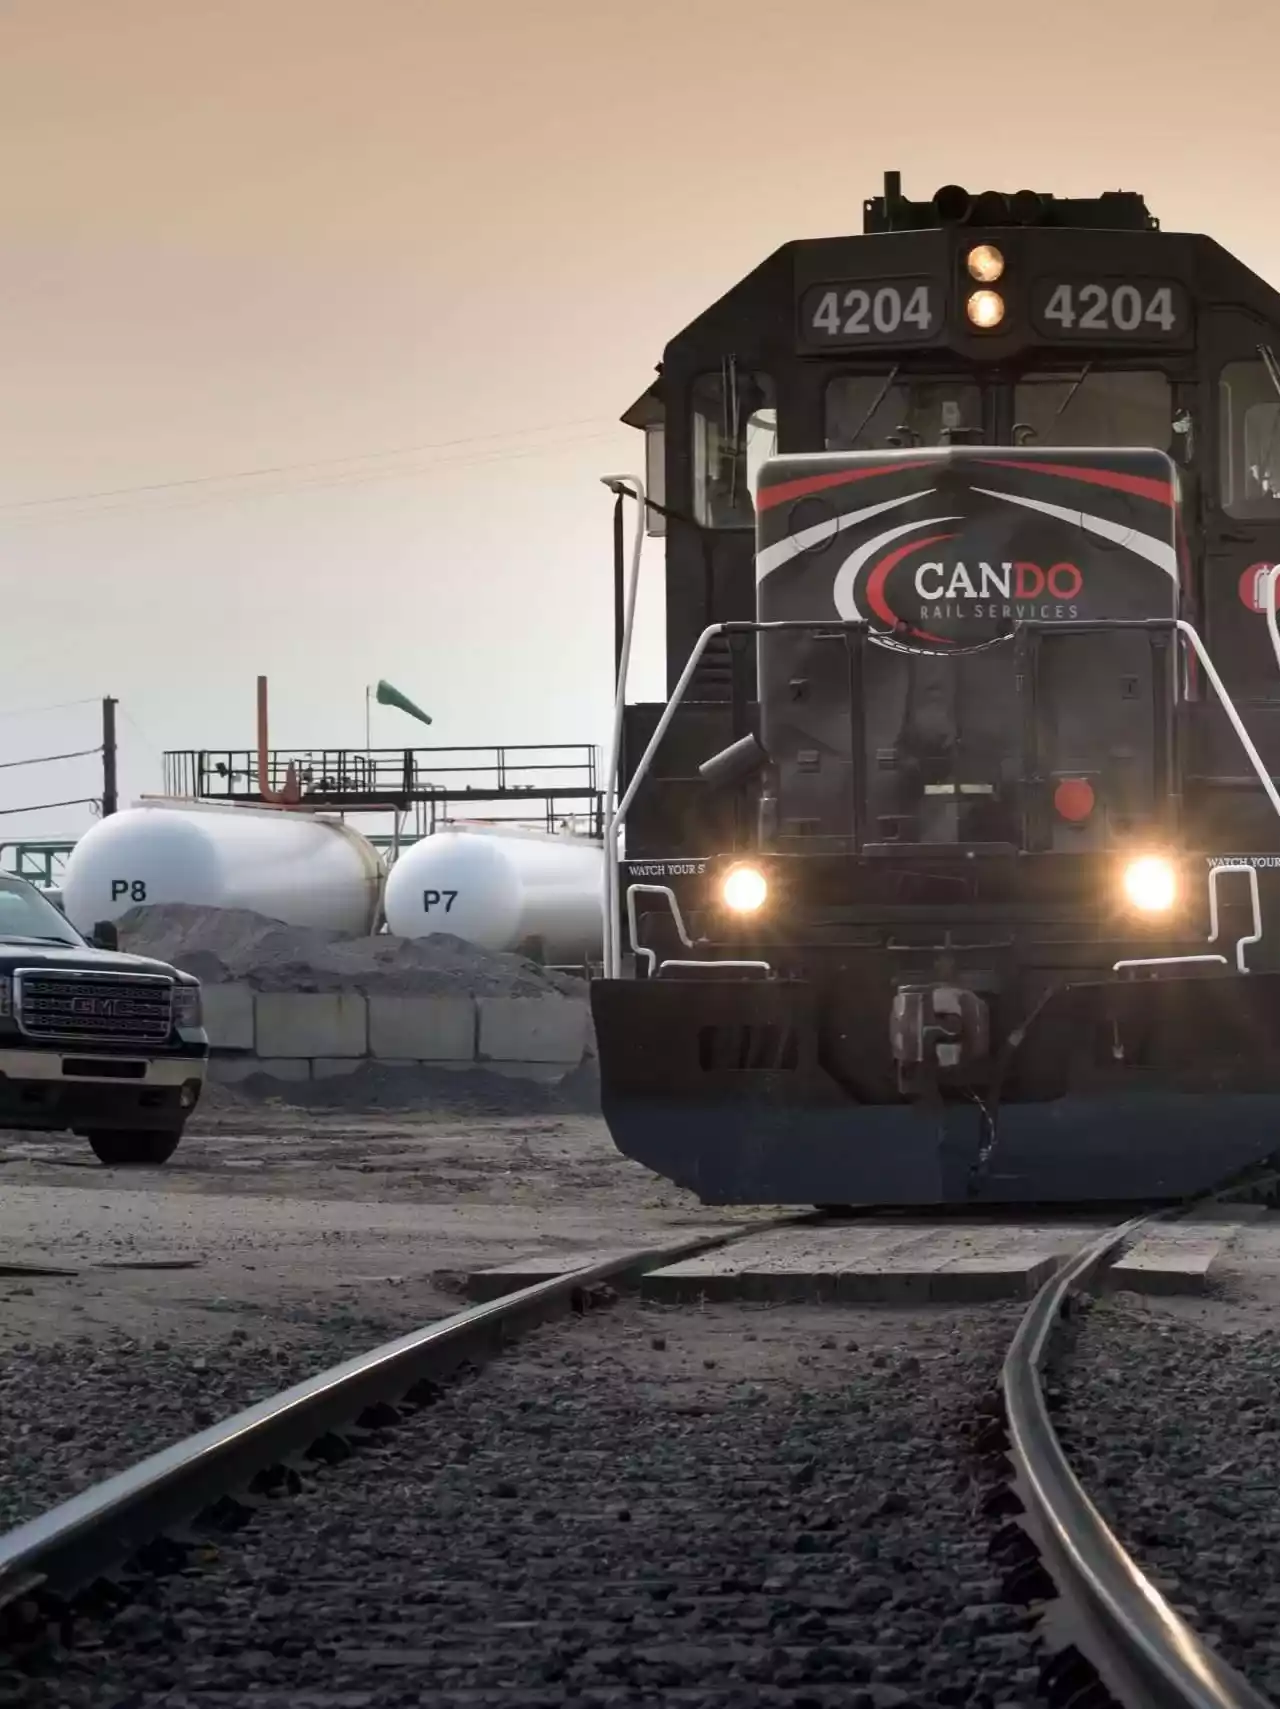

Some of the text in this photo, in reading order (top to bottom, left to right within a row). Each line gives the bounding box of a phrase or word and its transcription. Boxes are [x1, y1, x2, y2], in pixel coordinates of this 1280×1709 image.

[812, 286, 932, 335] 4204
[1044, 284, 1176, 331] 4204
[914, 562, 1083, 600] CANDO
[920, 605, 1078, 619] RAIL SERVICES
[628, 865, 665, 876] WATCH
[667, 864, 696, 875] YOUR
[1206, 857, 1248, 868] WATCH
[1250, 857, 1280, 867] YOUR
[111, 879, 147, 902] P8
[423, 889, 458, 913] P7
[71, 997, 134, 1018] GMC
